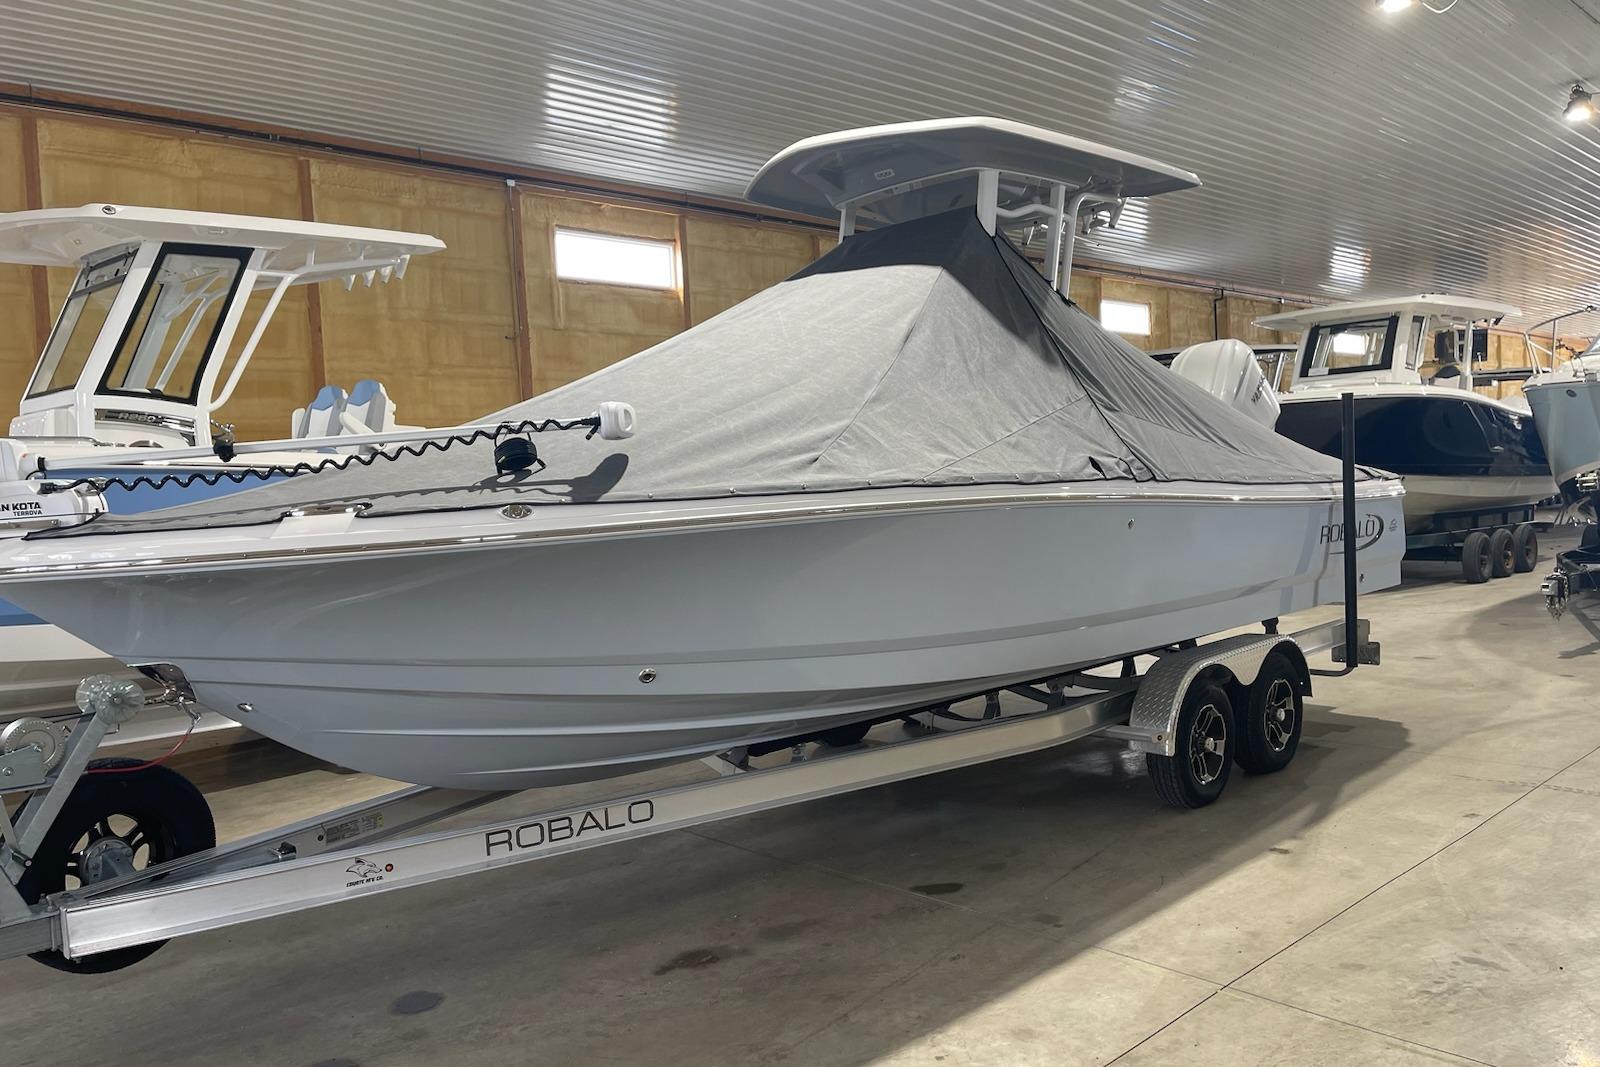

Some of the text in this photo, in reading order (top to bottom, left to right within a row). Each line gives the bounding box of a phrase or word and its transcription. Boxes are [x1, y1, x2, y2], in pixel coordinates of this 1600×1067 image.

[0, 501, 41, 512] N KOTA
[13, 509, 42, 517] TERROVA
[485, 799, 654, 857] ROBALO
